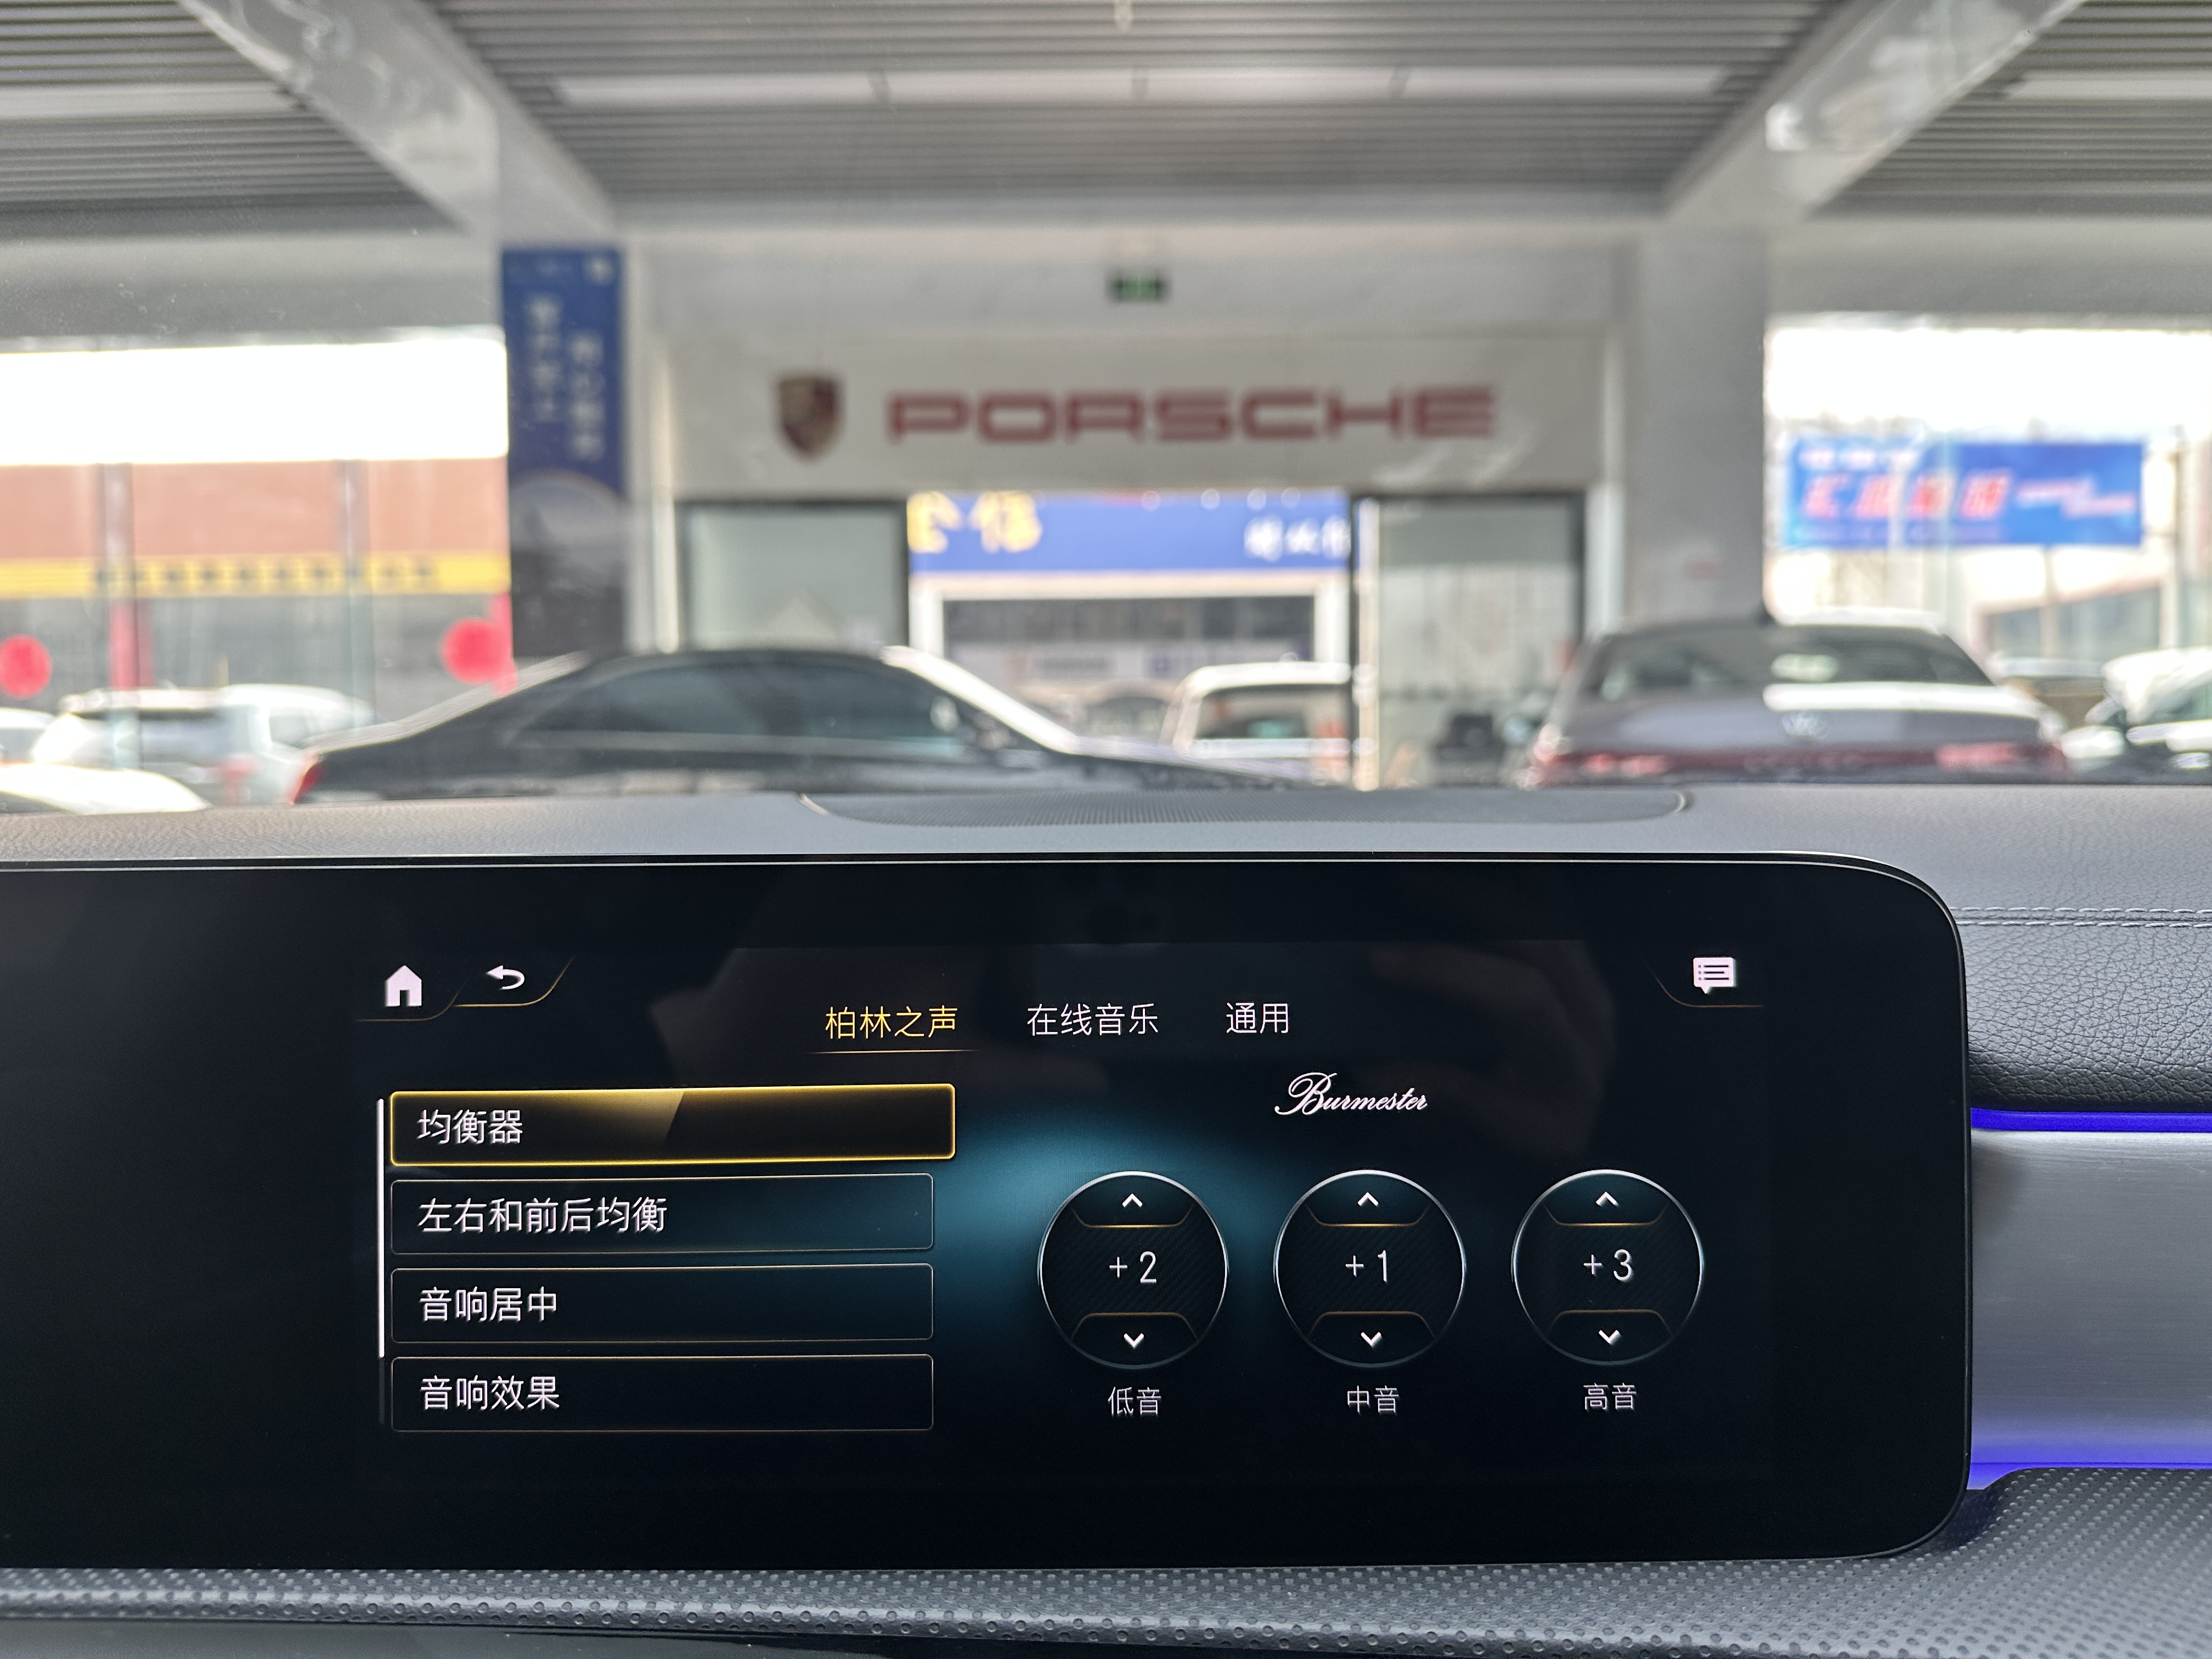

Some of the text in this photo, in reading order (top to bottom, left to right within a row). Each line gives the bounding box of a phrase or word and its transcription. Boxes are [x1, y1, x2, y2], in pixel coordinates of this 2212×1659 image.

[886, 385, 1497, 443] PORSCHE
[825, 1005, 958, 1039] 柏林之声
[1027, 1002, 1159, 1036] 在线音乐
[1226, 1001, 1290, 1034] 通用
[1274, 1072, 1427, 1115] Burmester
[417, 1109, 523, 1144] 均衡器
[417, 1197, 667, 1233] 左右和前后均衡
[419, 1286, 557, 1322] 音响居中
[420, 1374, 560, 1410] 音响效果
[1107, 1386, 1161, 1416] 低音
[1347, 1385, 1400, 1414] 中音
[1583, 1382, 1637, 1412] 高音
